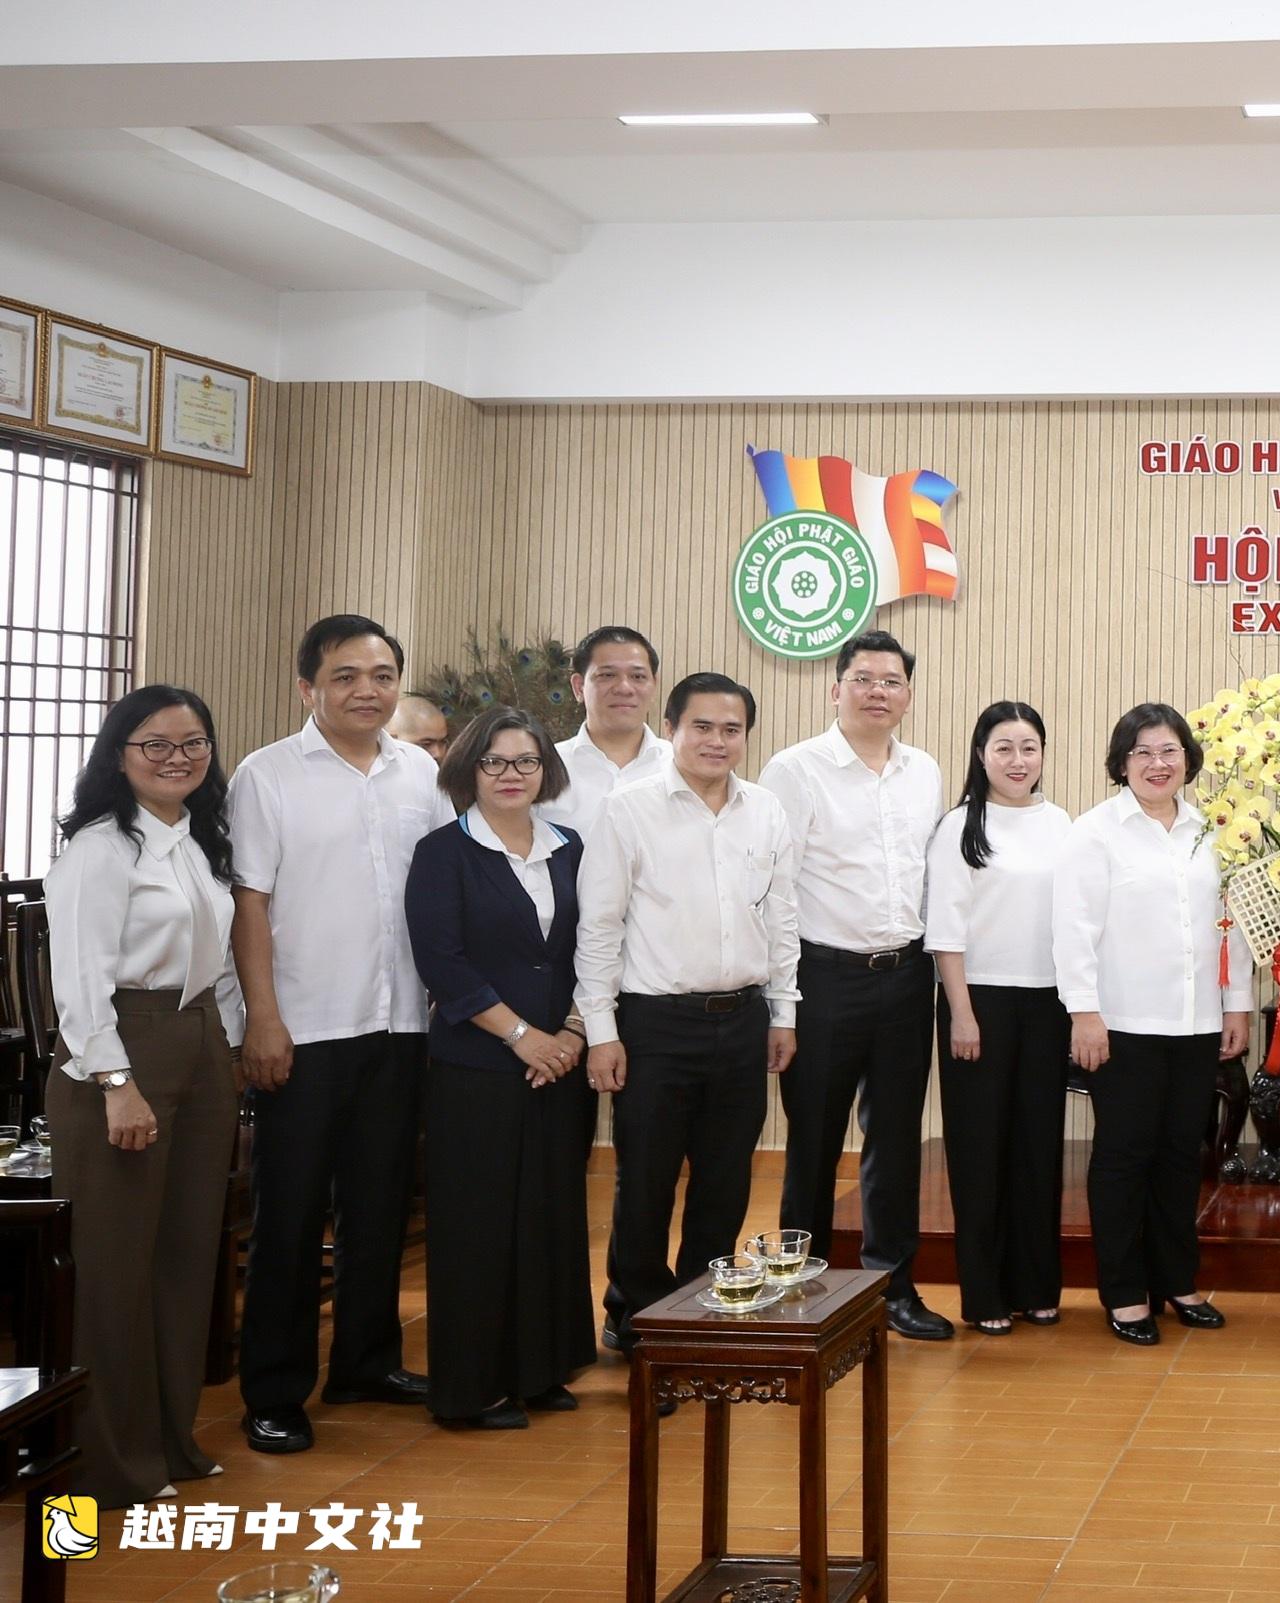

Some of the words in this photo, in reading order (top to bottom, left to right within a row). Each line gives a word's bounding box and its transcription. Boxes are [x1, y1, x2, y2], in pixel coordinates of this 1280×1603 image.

[1140, 435, 1241, 473] GIÁO
[745, 552, 766, 594] GIÁO
[763, 526, 794, 552] HỘI
[799, 523, 844, 548] PHẬT
[841, 546, 865, 588] GIÁO
[764, 619, 803, 647] VIỆT
[806, 620, 843, 647] NAM
